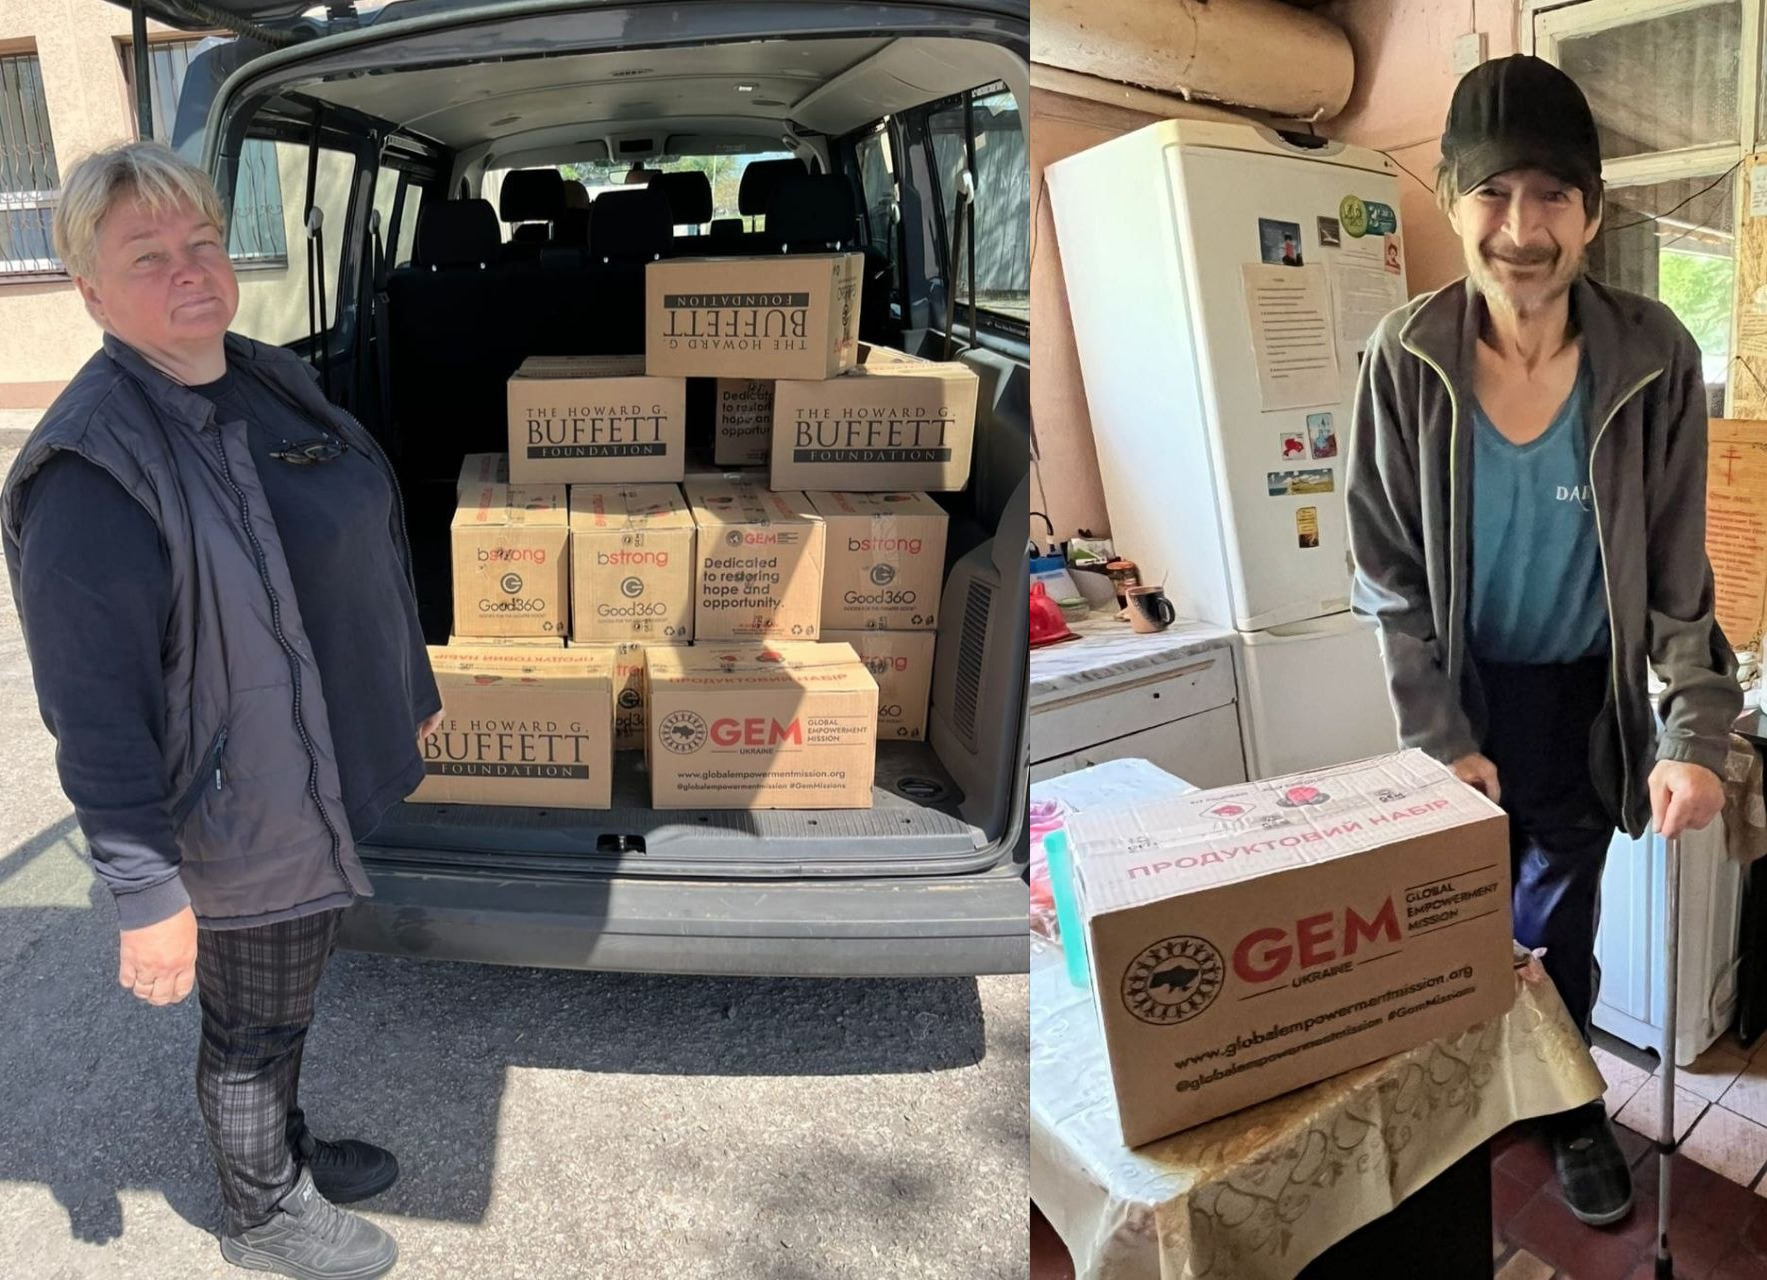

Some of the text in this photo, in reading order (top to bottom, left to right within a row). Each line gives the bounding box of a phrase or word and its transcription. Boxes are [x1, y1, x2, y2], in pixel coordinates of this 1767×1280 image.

[677, 295, 792, 306] FOUNDATION
[663, 309, 807, 337] BUFFETT
[688, 339, 761, 350] HOWARD
[774, 340, 807, 350] THE
[526, 408, 557, 418] THE
[568, 405, 641, 417] HOWARD
[722, 403, 733, 412] to
[796, 407, 956, 419] THE HOWARD G.
[527, 416, 667, 445] BUFFETT
[795, 419, 956, 448] BUFFETT
[542, 445, 653, 457] FOUNDATION
[810, 450, 936, 461] FOUNDATION
[744, 533, 777, 544] GEM
[848, 537, 922, 554] bstrong
[477, 548, 546, 564] bstrong
[597, 549, 669, 566] bstrong
[704, 557, 777, 568] Dedicated
[703, 571, 780, 584] to restoring
[703, 584, 770, 597] hope and
[844, 590, 916, 604] Good360
[478, 598, 545, 611] Good360
[597, 602, 667, 617] Good360
[703, 597, 784, 610] opportunity.
[470, 720, 557, 732] HOWARD
[570, 721, 589, 733] G.
[808, 719, 838, 727] GLOBAL
[710, 717, 803, 747] GEM
[808, 726, 867, 734] EMPOWERMENT
[424, 732, 590, 763] BUFFETT
[441, 765, 573, 777] FOUNDATION
[677, 770, 846, 781] www.globalempowermentmission.org
[1128, 821, 1363, 880] ПРОДУКТОВИЙ
[1369, 799, 1450, 825] НАБІР
[1405, 883, 1455, 903] GLOBAL
[1407, 882, 1499, 918] EMPOWERMENT
[1408, 909, 1458, 931] MISSION
[1232, 896, 1402, 984] GEM
[1292, 961, 1353, 988] UKRAINE
[1174, 965, 1473, 1070] www.globalempowermentmission.org
